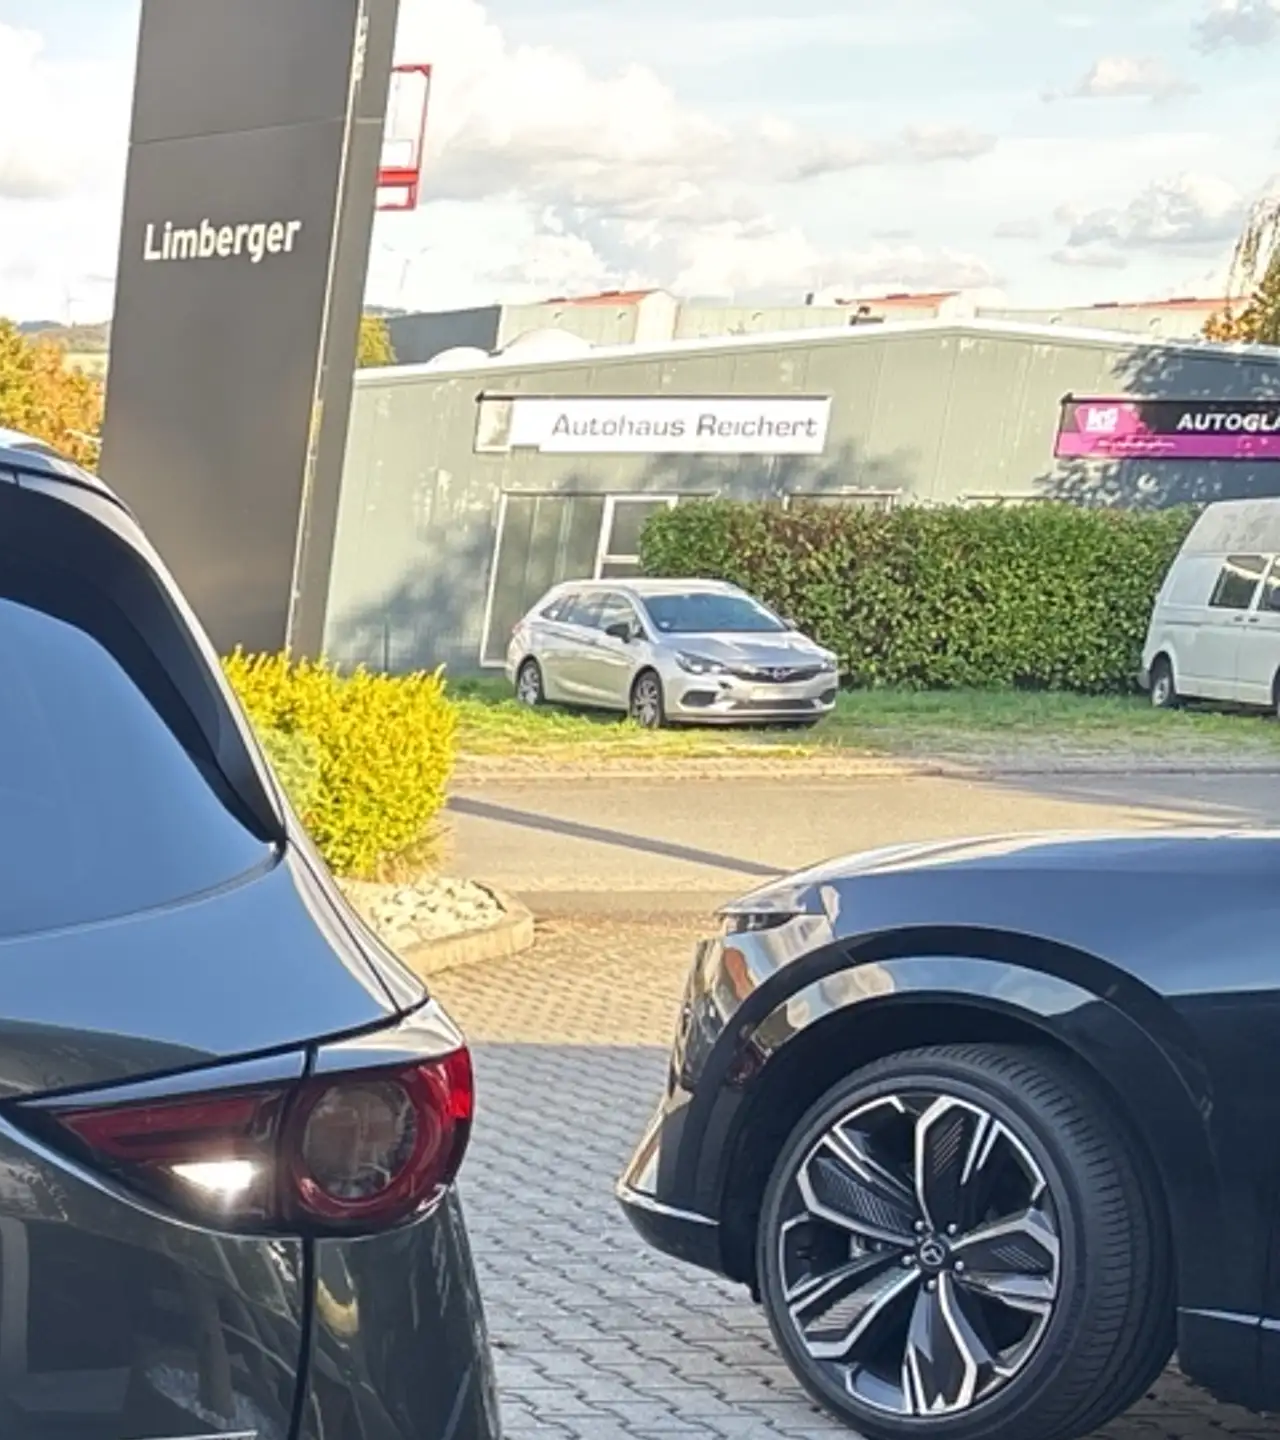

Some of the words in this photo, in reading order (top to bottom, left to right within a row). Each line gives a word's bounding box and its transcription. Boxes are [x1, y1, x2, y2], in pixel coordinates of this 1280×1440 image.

[143, 218, 302, 264] Limberger
[551, 413, 686, 438] Autohaus
[695, 413, 818, 438] Reichert
